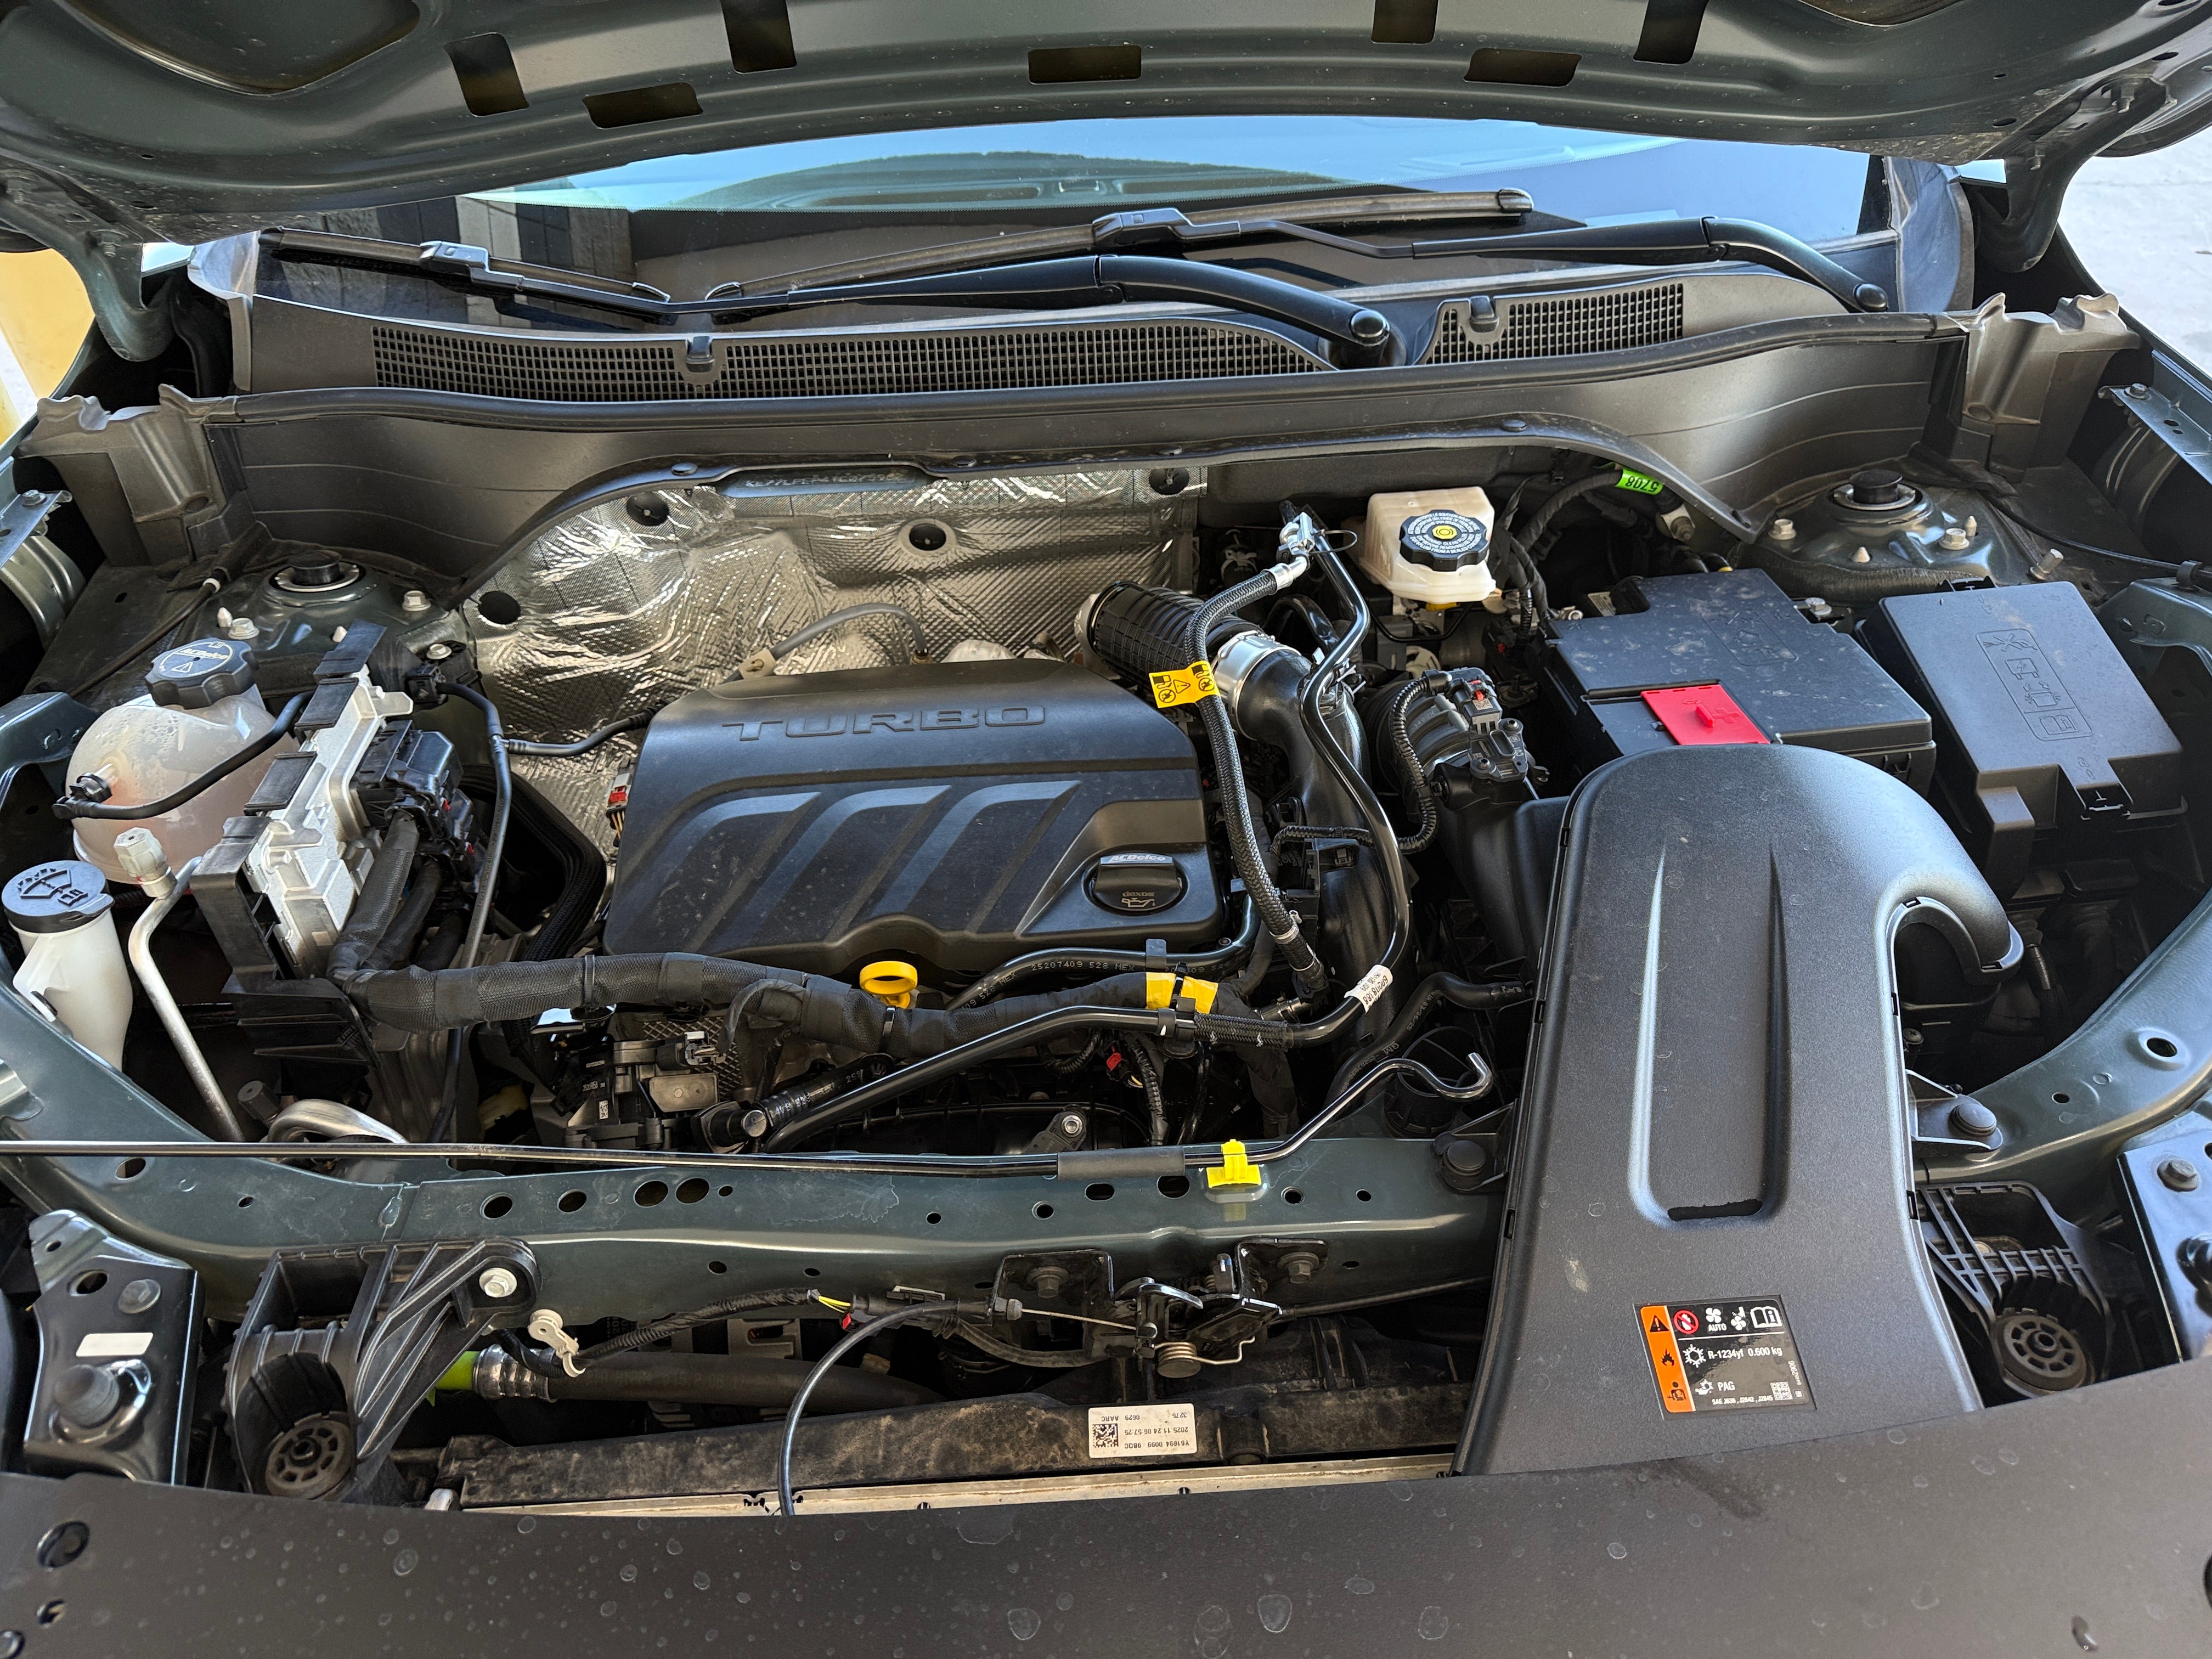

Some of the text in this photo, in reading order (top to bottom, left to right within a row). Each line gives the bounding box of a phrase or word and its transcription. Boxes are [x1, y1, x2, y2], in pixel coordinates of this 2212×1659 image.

[1625, 476, 1659, 492] 5708
[722, 706, 1046, 741] TURBO
[1031, 961, 1084, 971] 25207409
[1115, 963, 1135, 972] MEX
[1381, 1041, 1400, 1054] GM
[1708, 1323, 1727, 1332] AUTO
[1707, 1346, 1783, 1359] R-1234yf 0.600 kg
[1717, 1381, 1735, 1392] PAG
